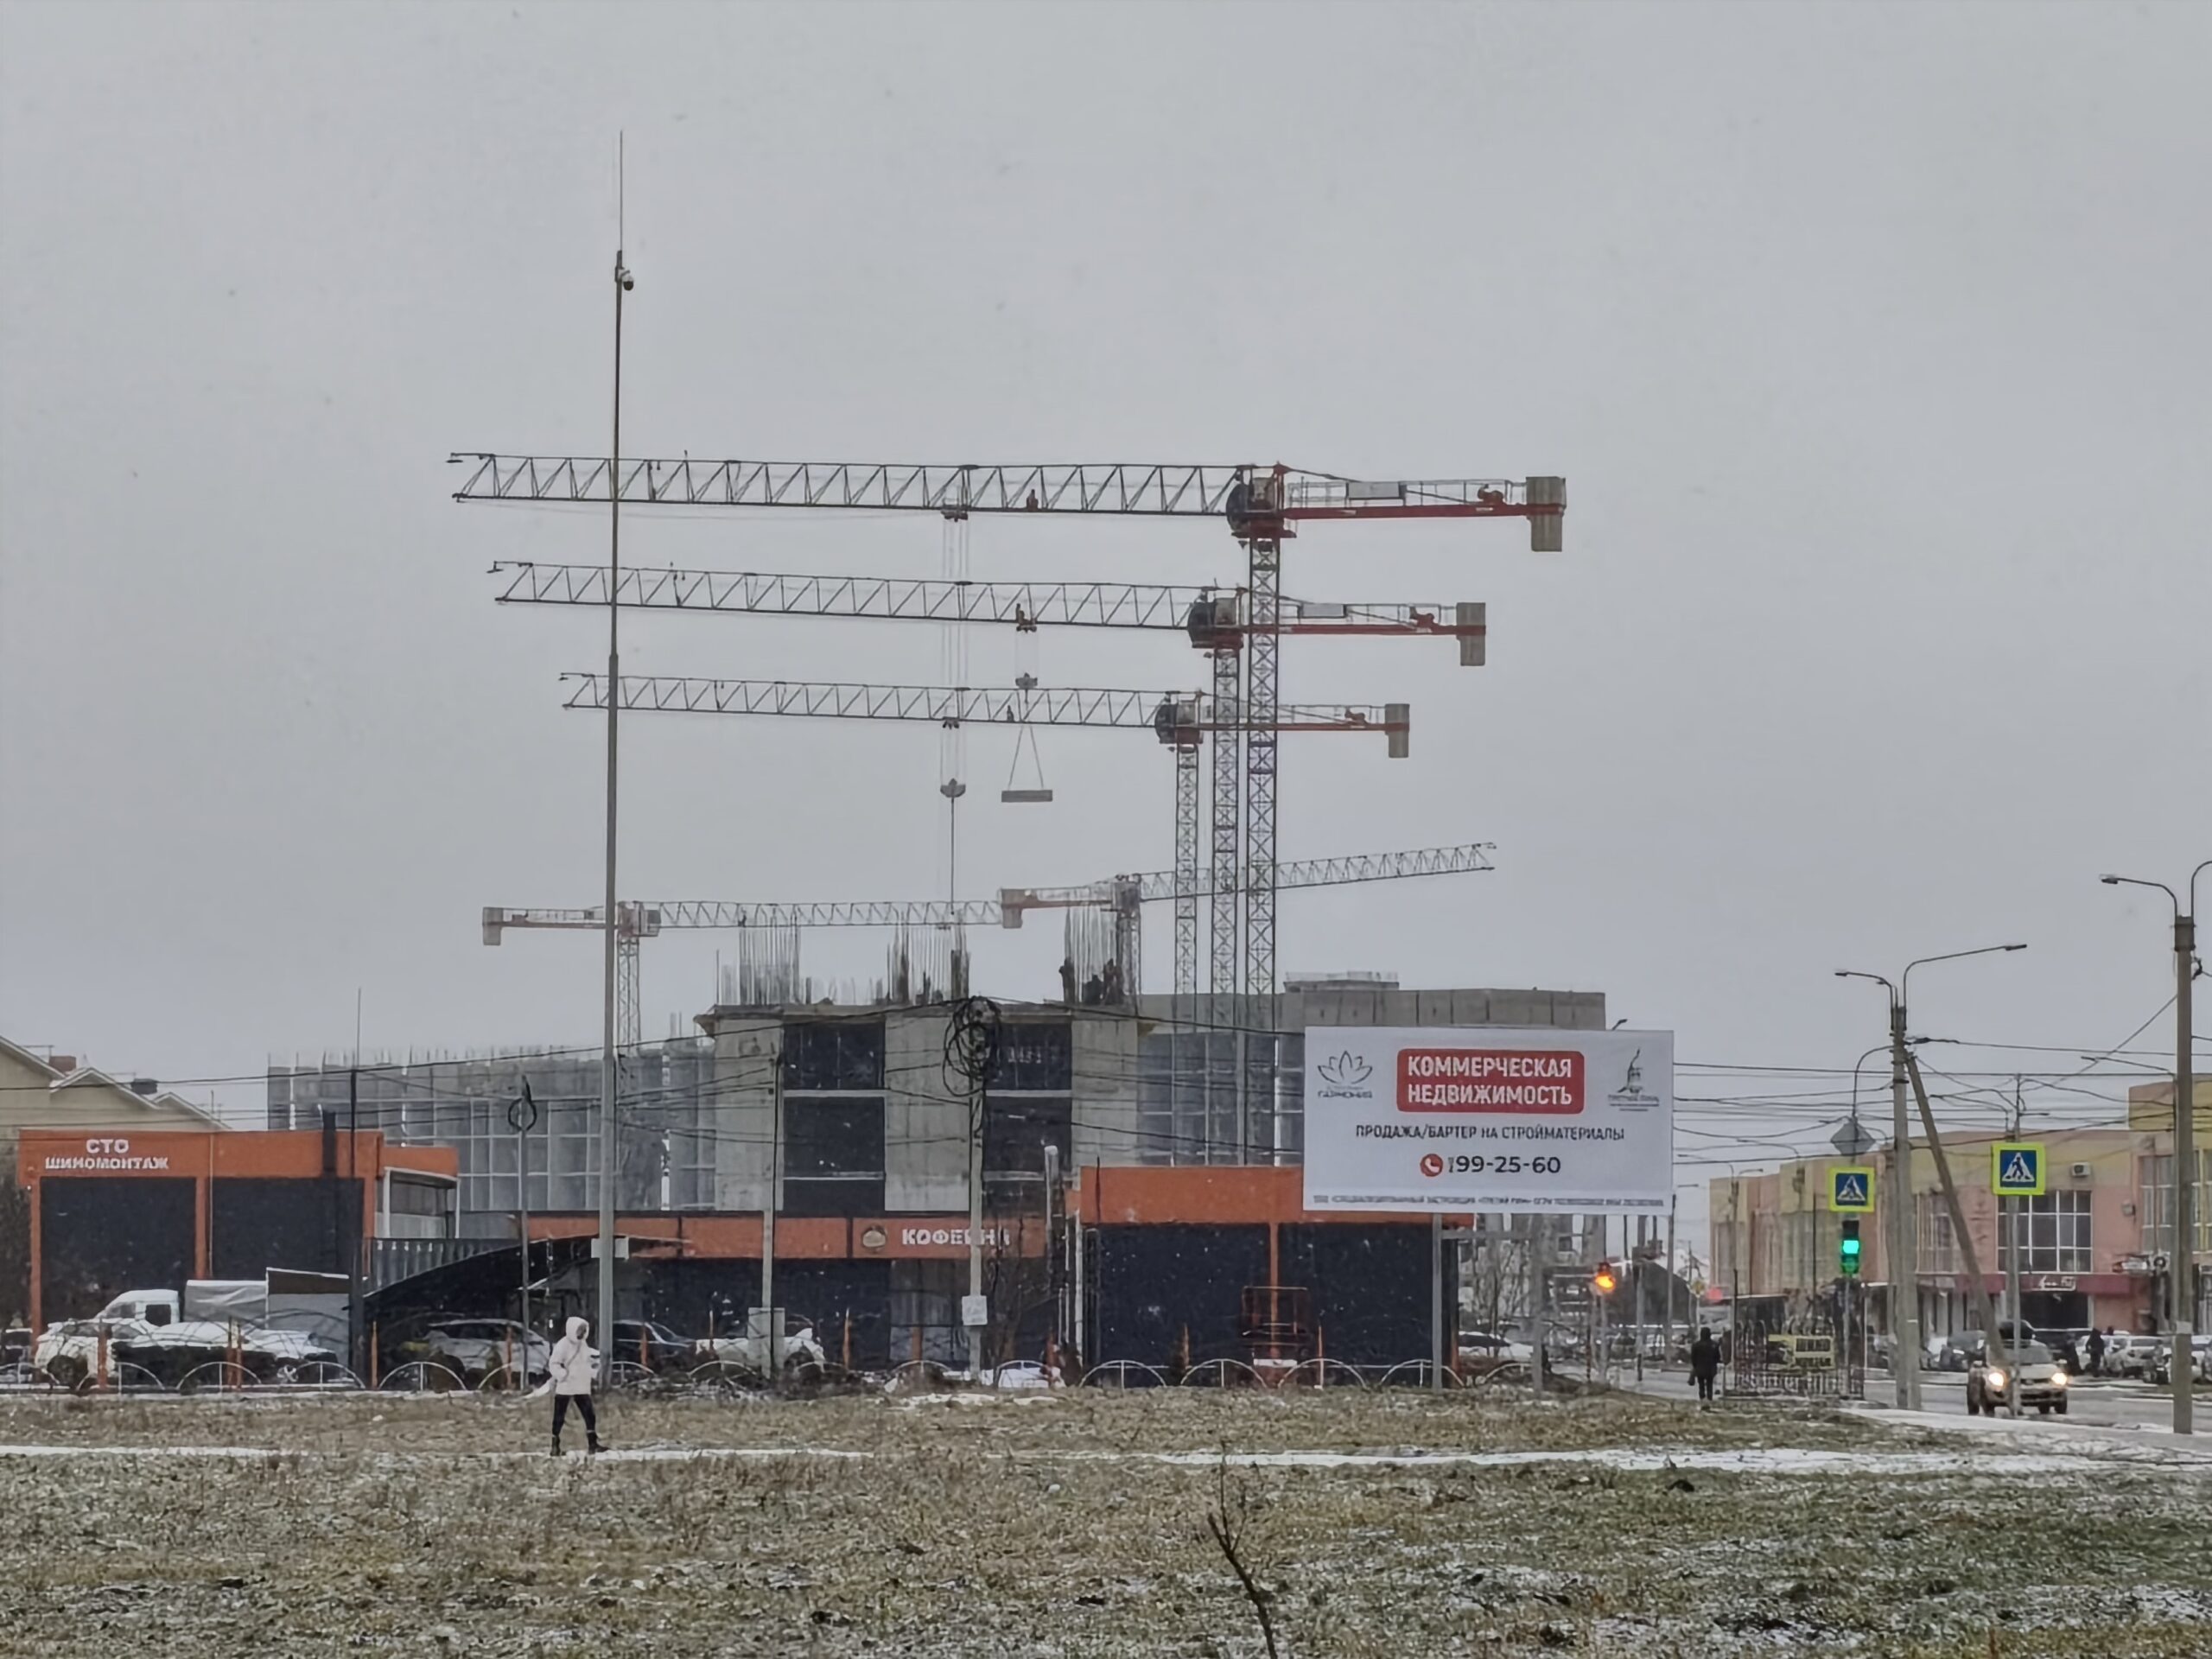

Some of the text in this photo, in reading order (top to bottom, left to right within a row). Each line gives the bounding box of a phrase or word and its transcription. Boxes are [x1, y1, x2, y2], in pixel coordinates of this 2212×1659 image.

[1408, 1055, 1572, 1078] КОММЕРЧЕСКАЯ
[1408, 1084, 1573, 1106] НЕДВИЖИМОСТЬ
[1481, 1127, 1498, 1139] НА
[1502, 1124, 1624, 1141] СТРОЙМАТЕРИАЛЫ
[86, 1138, 130, 1154] СТО
[45, 1156, 169, 1170] ШИНОМОНТАЖ
